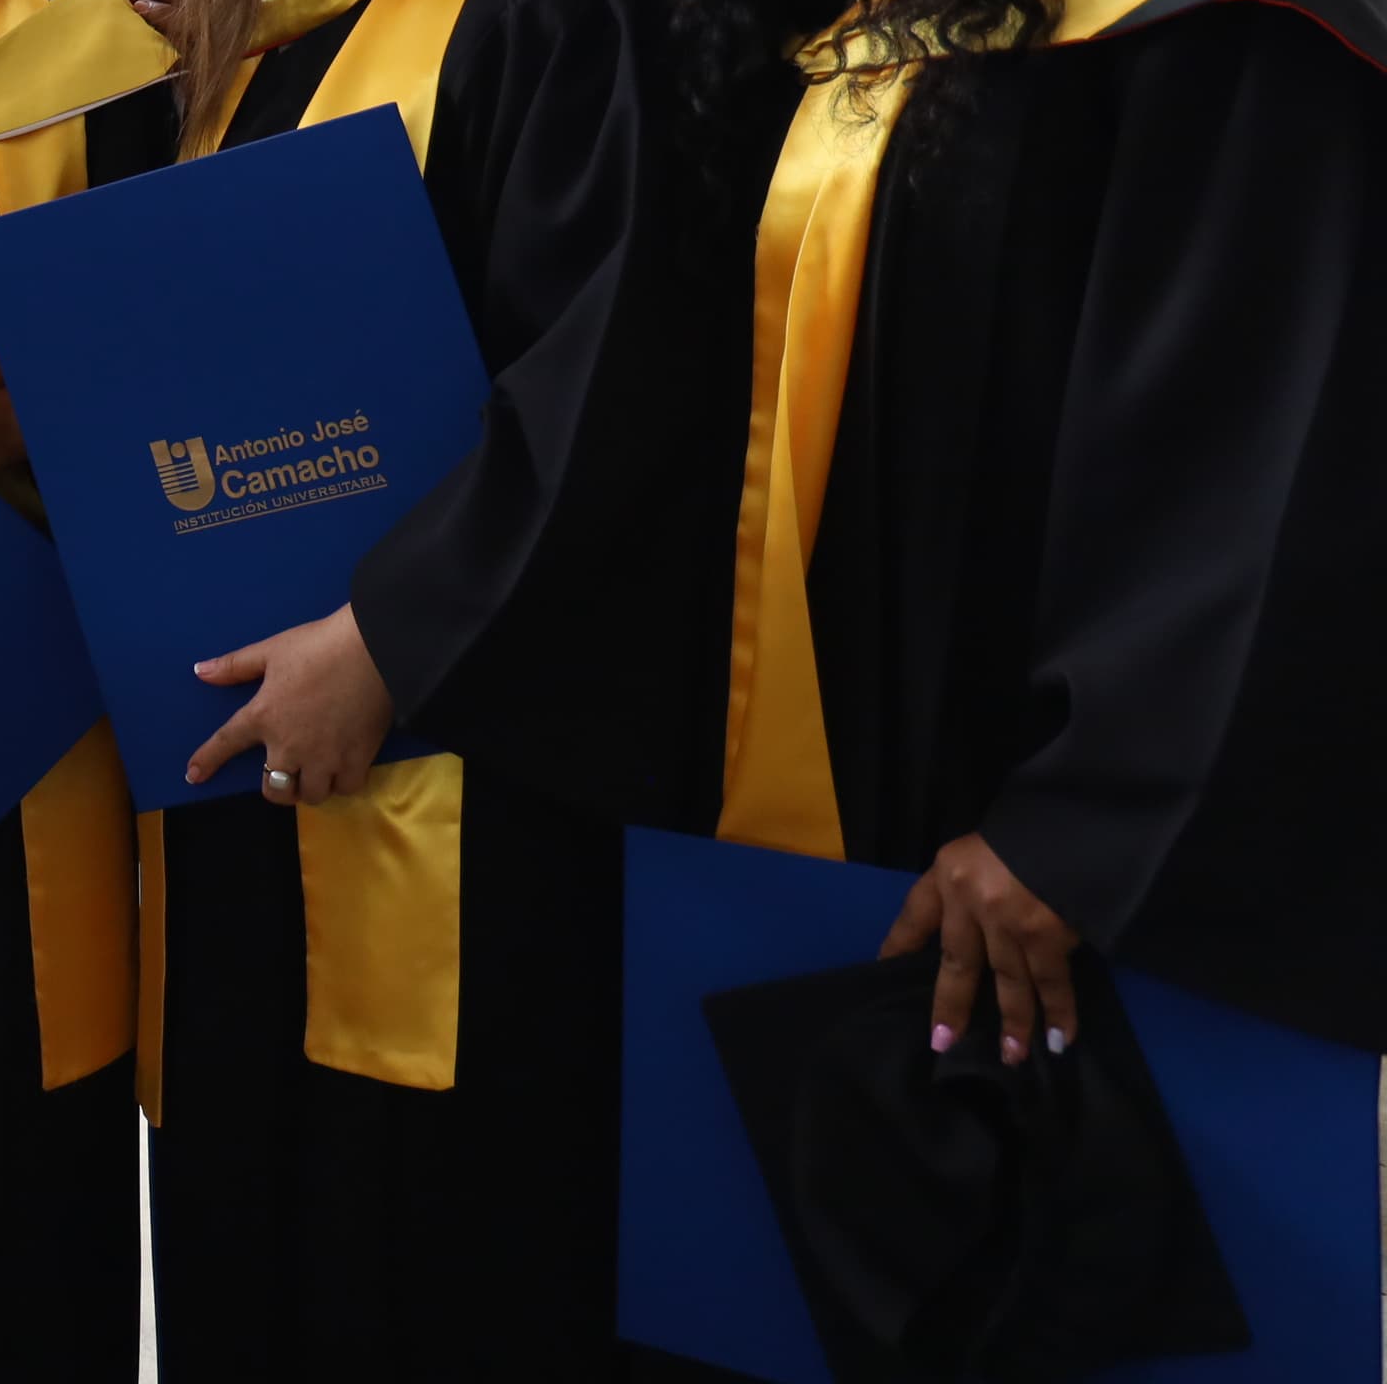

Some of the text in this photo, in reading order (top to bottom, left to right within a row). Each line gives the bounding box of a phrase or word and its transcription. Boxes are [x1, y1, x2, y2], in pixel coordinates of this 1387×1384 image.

[215, 408, 370, 466] Antonio José
[221, 445, 381, 500] Camacho
[173, 473, 388, 531] INSTITUCIÓN UNIVERSITARIA
